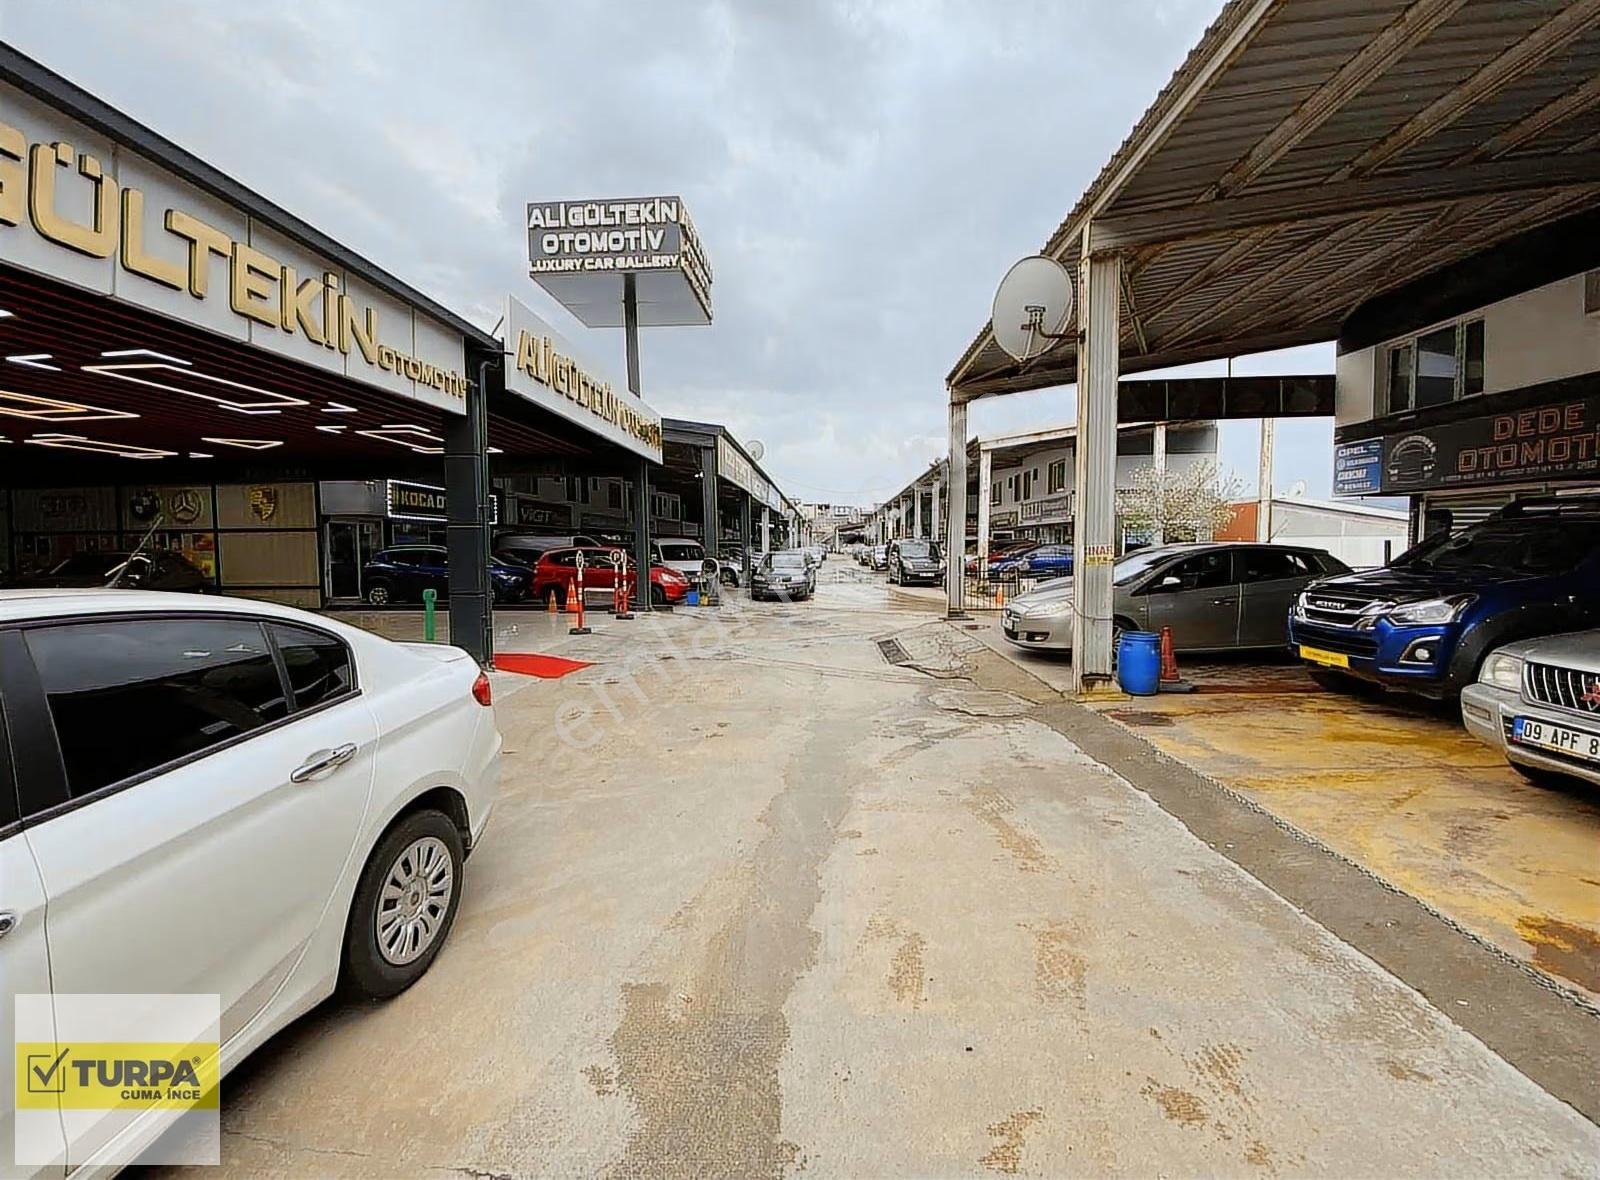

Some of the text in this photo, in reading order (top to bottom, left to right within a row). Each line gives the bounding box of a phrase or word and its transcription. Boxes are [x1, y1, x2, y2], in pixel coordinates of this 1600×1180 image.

[529, 199, 677, 229] ALİ GÜLTEKİN
[542, 226, 665, 254] OTOMOTİV
[529, 255, 679, 272] LUXURY CAR GALLERY
[378, 343, 467, 398] OTOMOTİV
[517, 329, 551, 388] ALİ
[1494, 403, 1585, 441] DEDE
[1338, 446, 1368, 456] OPEL
[1524, 722, 1542, 740] 09
[1550, 728, 1580, 750] APF
